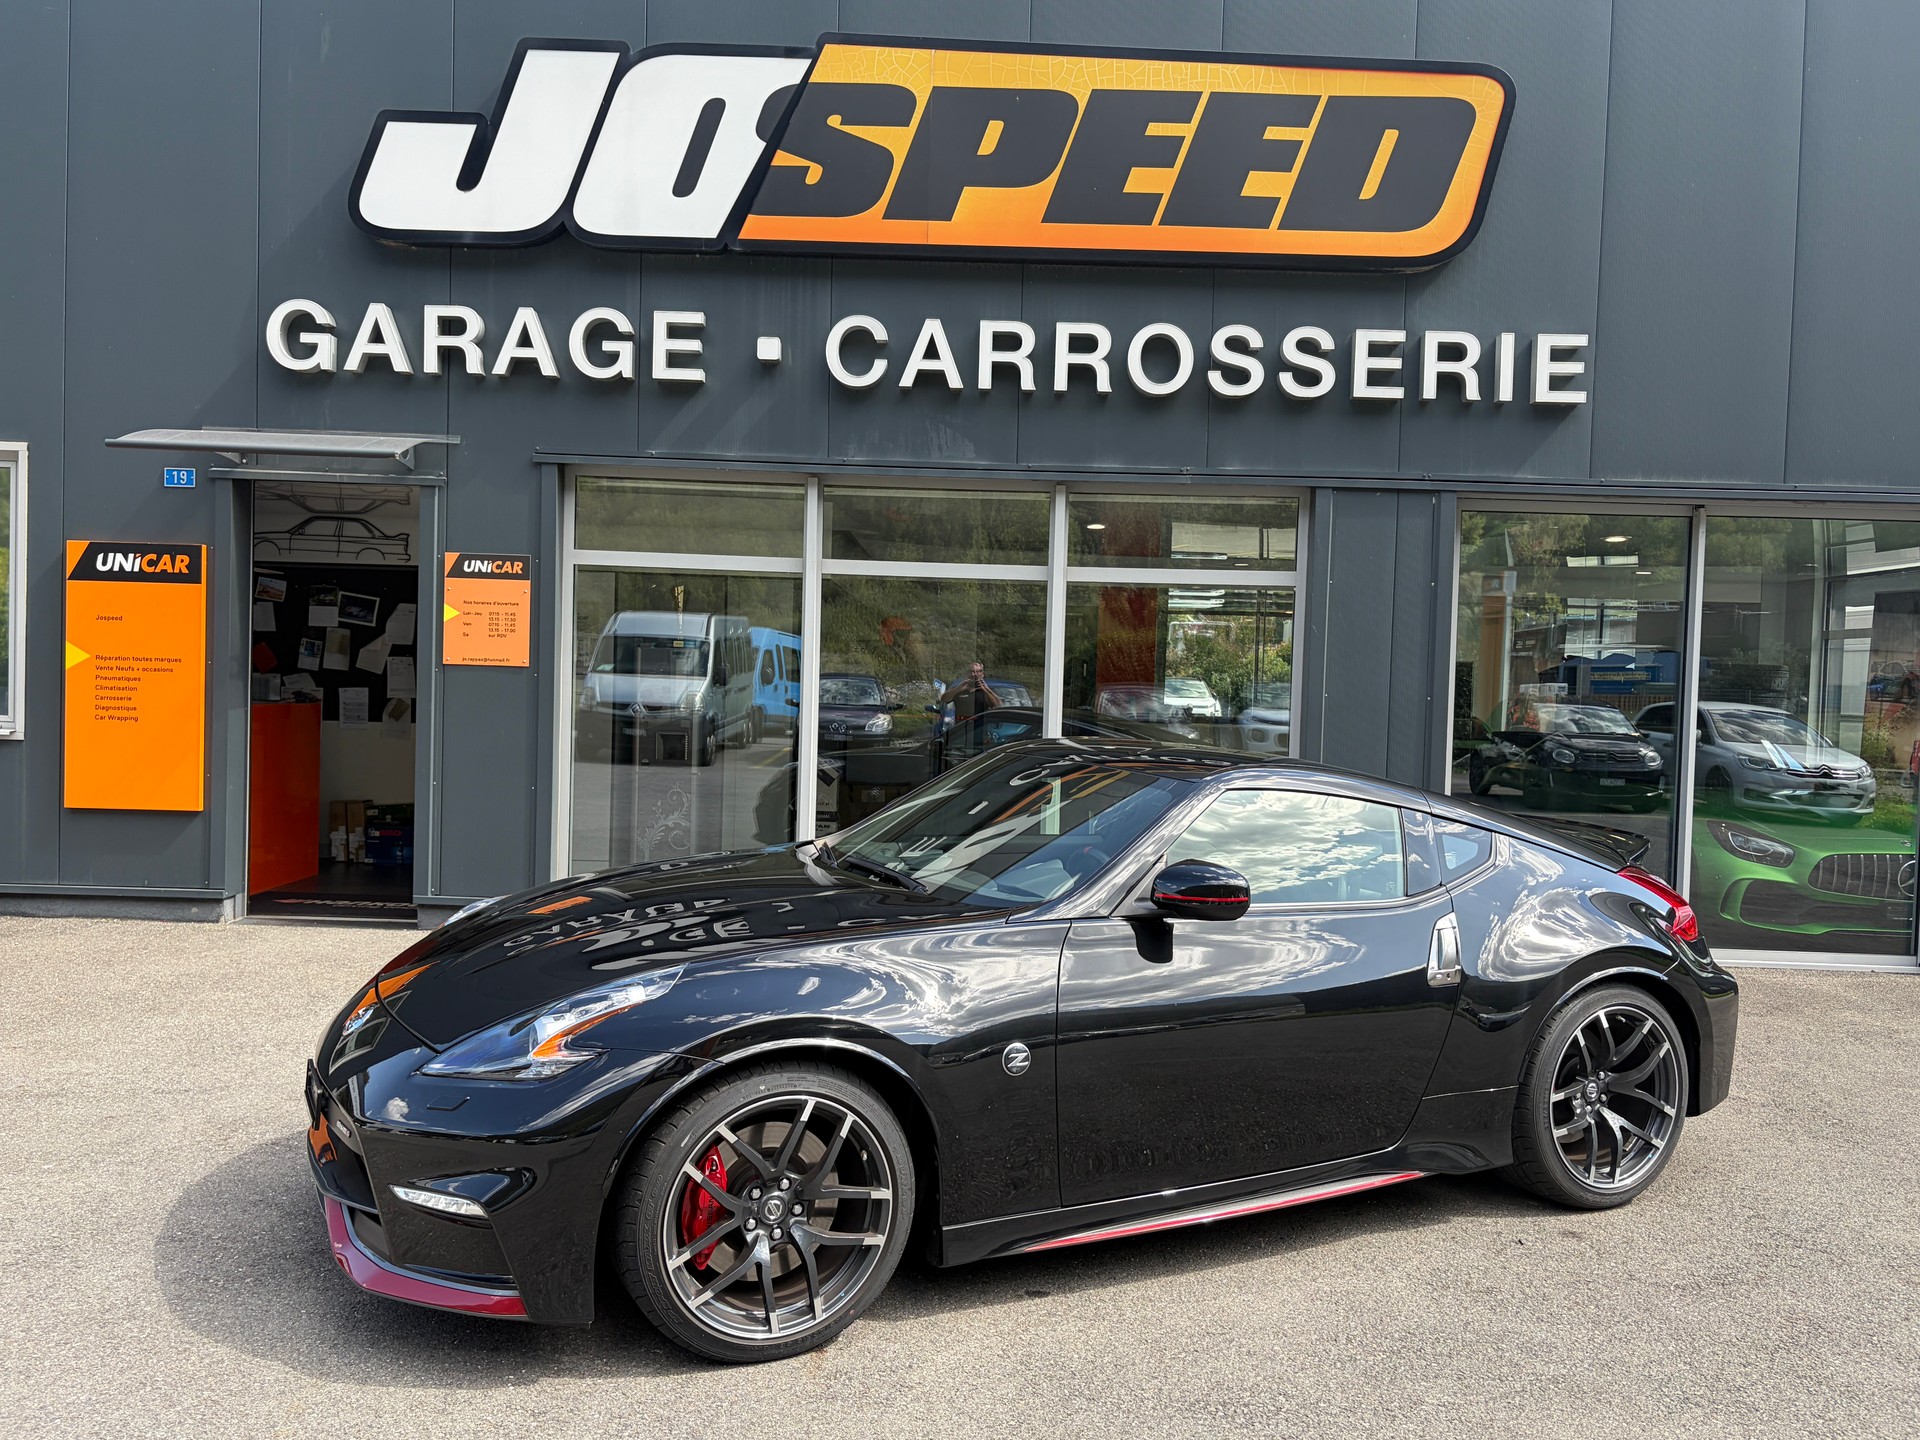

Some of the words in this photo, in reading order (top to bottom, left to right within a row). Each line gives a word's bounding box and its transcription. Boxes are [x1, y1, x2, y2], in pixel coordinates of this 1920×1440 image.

[265, 298, 707, 384] GARAGE
[824, 314, 1589, 405] CARROSSERIE
[172, 470, 187, 484] 19
[95, 614, 123, 622] Jospeed
[95, 654, 131, 663] Réparation
[95, 664, 114, 672] Vente
[95, 674, 142, 683] Pneumatiques
[94, 684, 138, 692] Climatisation
[94, 694, 133, 702] Carrosserie
[94, 704, 138, 713] Diagnostique
[107, 714, 139, 723] Wrapping
